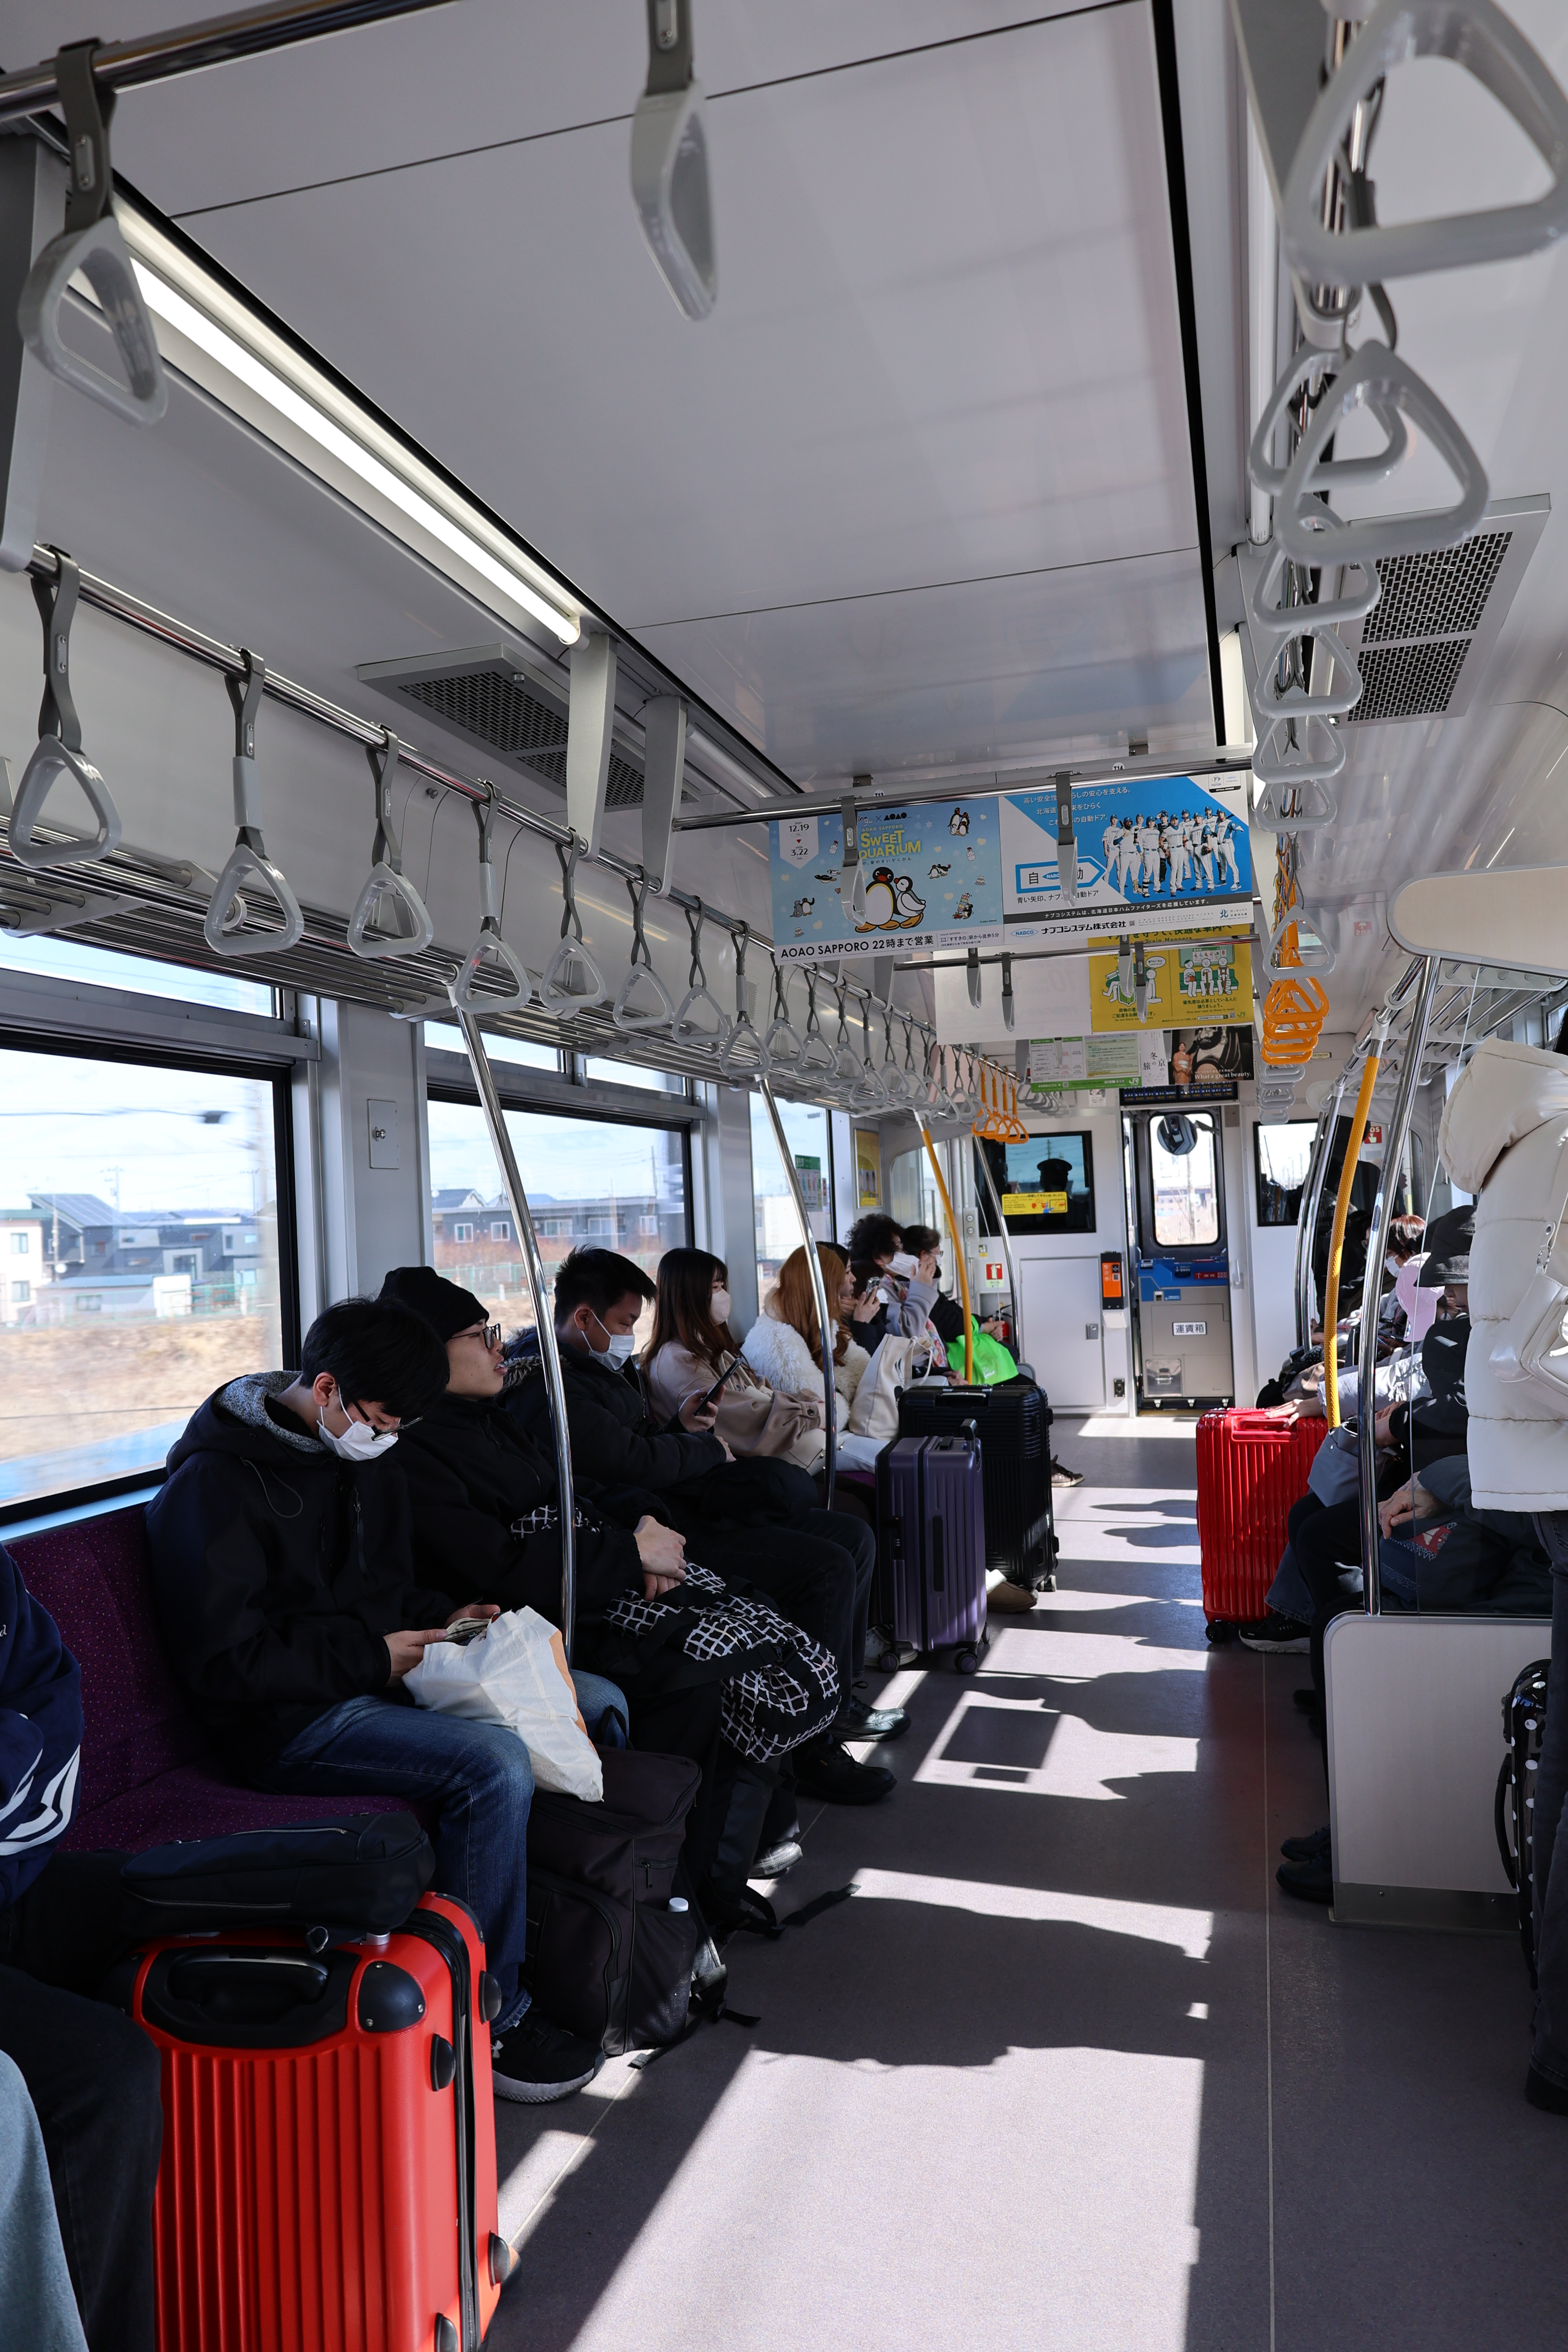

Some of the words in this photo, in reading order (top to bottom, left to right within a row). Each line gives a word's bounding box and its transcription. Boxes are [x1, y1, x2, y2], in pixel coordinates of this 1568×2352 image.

[1023, 787, 1131, 804] 高い安全性らしの安心を支える。
[788, 824, 809, 832] 12.19
[861, 830, 905, 848] SWEET
[790, 848, 808, 856] 3.22
[859, 840, 921, 860] QUARIUM
[1029, 871, 1039, 885] 自
[1044, 899, 1210, 918] ナブコシステムは、北海道日本ハムファイターズを応援しています。
[1041, 920, 1127, 934] ナブコシステム株式会社
[781, 946, 815, 958] AOAO
[818, 941, 869, 955] SAPPORO
[872, 935, 934, 949] 22時まで営業
[1143, 1062, 1151, 1071] 旅
[1175, 1323, 1204, 1334] 運賃箱
